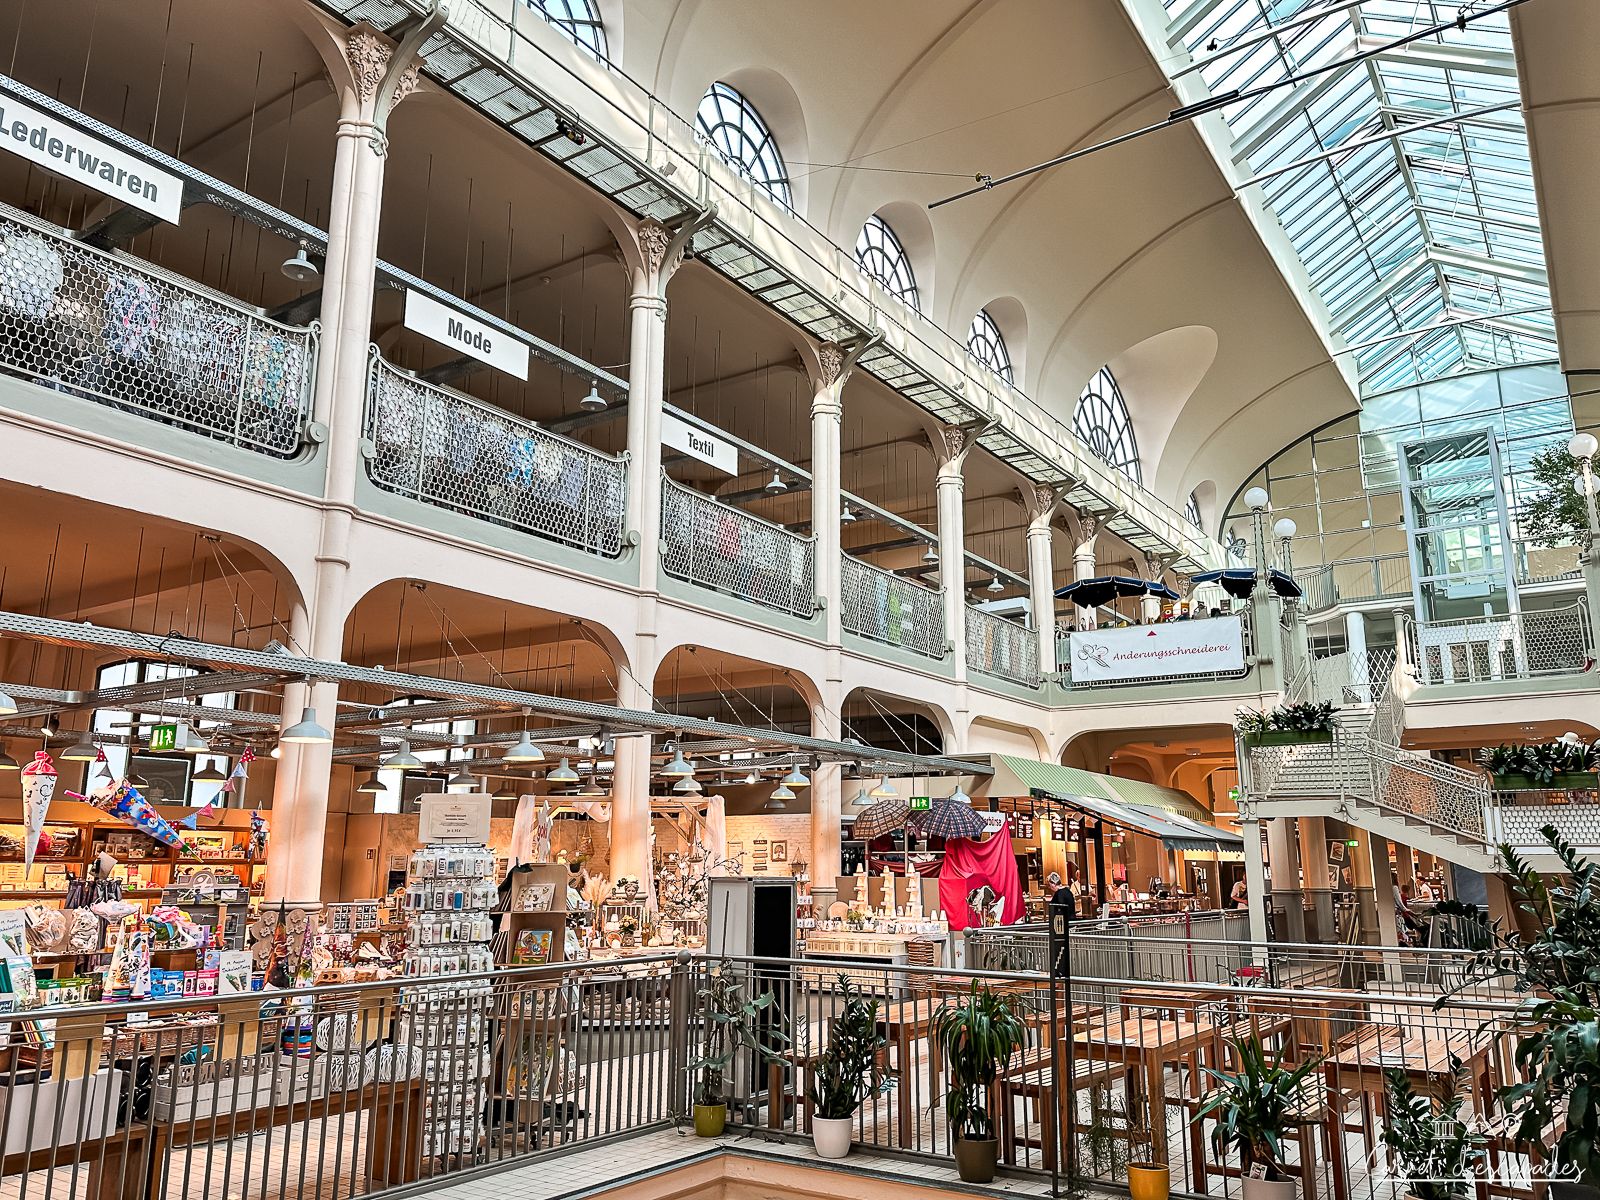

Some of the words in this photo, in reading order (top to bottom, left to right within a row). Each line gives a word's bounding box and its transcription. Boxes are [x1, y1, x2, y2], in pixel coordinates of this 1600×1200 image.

[0, 106, 159, 203] Lederwaren
[447, 316, 493, 355] Mode
[687, 431, 715, 459] Textil
